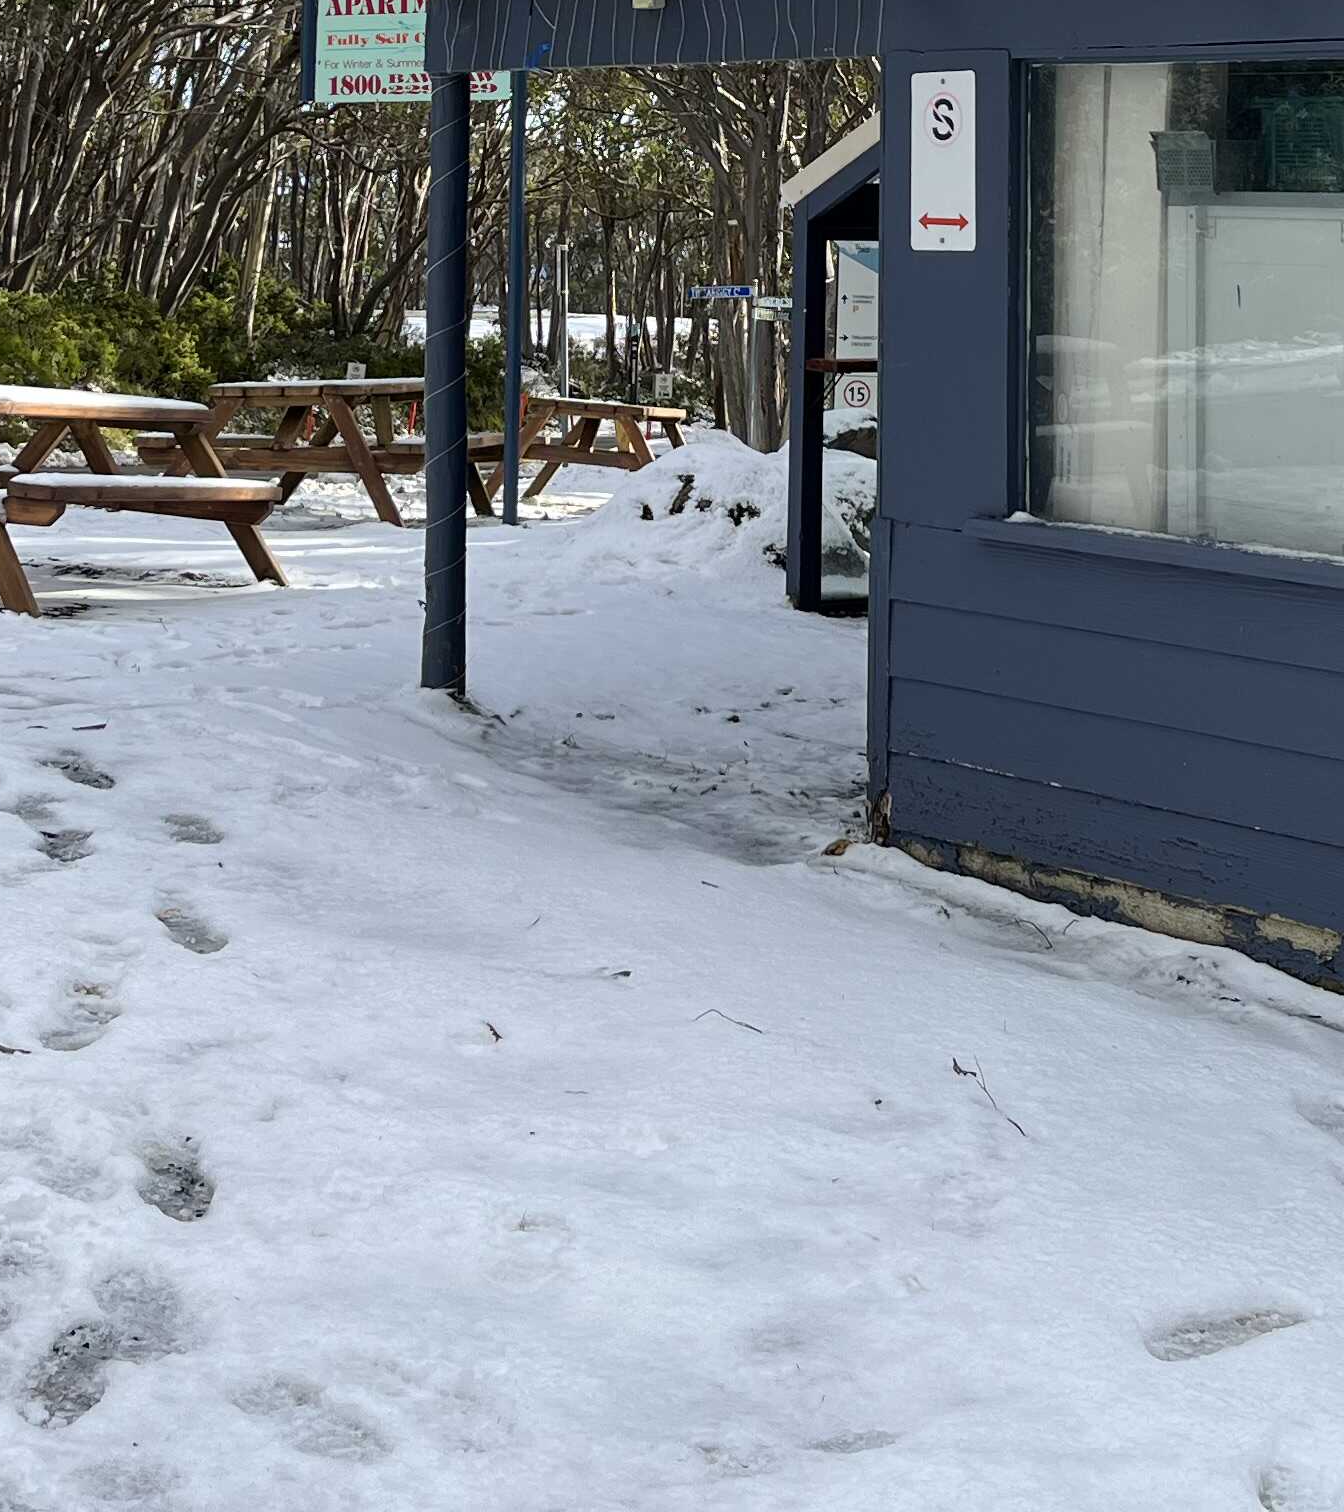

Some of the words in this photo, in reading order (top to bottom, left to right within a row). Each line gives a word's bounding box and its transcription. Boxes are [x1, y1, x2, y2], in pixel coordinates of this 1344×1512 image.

[327, 34, 369, 47] Fully
[376, 33, 408, 45] Self
[324, 59, 339, 69] For
[343, 59, 372, 69] Winter
[848, 386, 865, 402] 15
